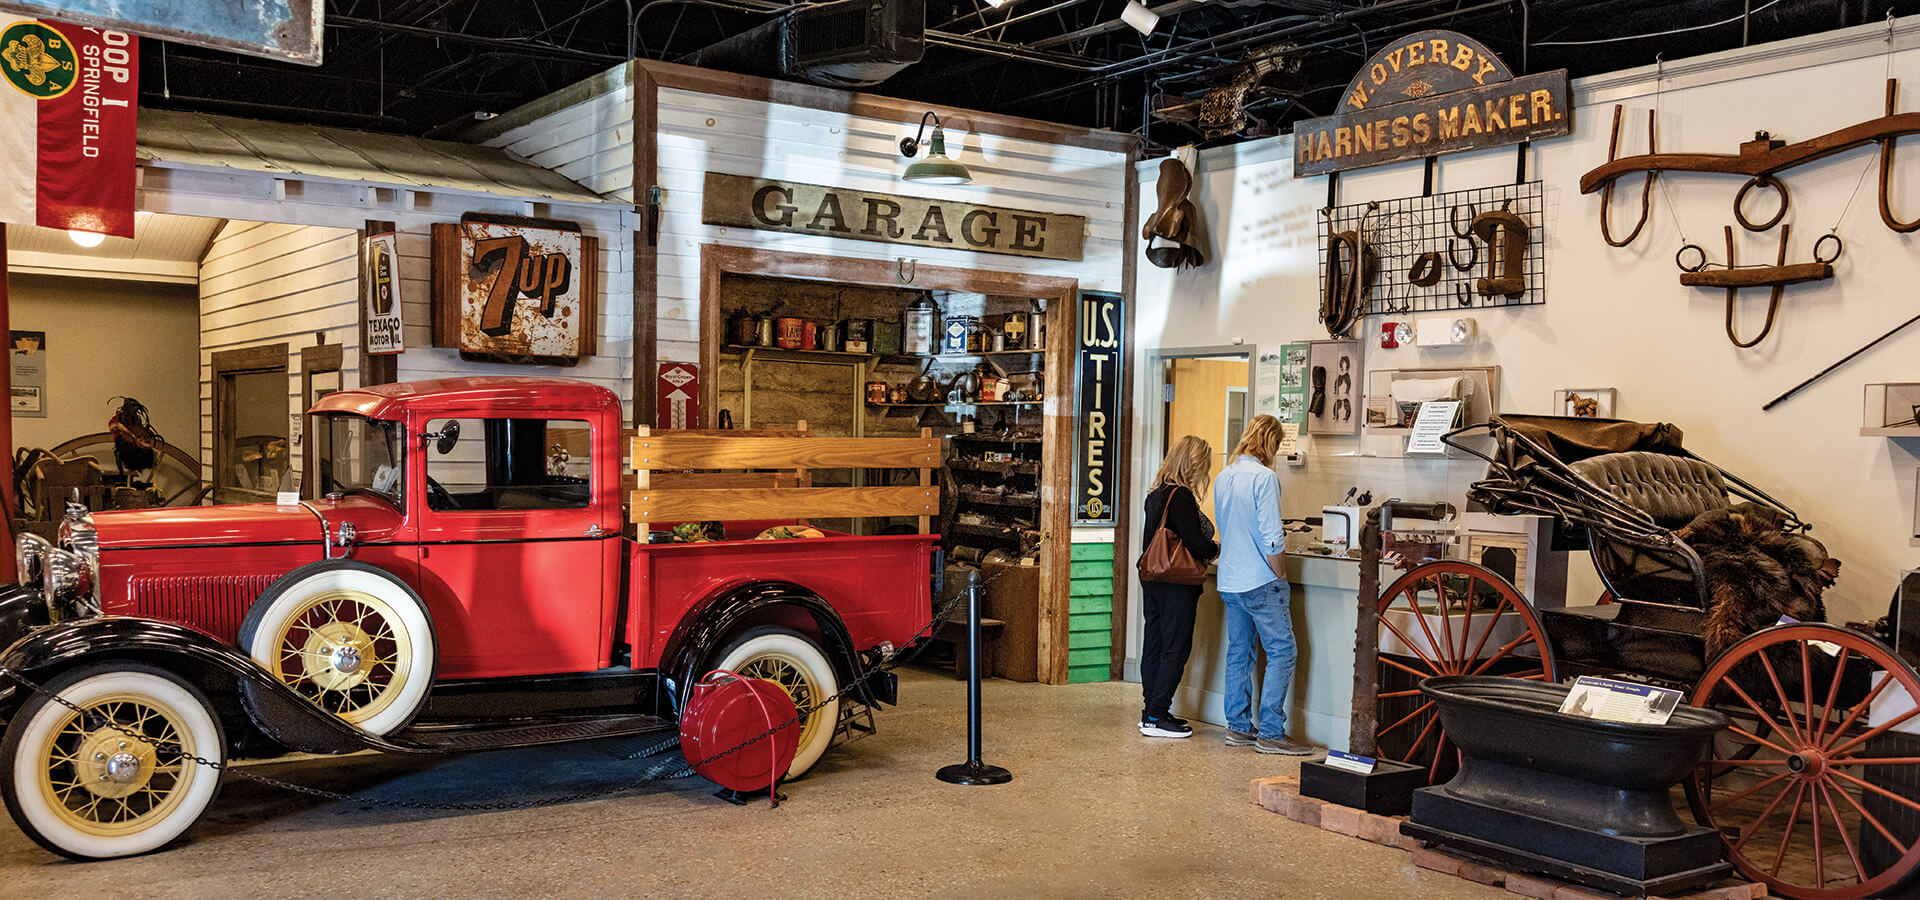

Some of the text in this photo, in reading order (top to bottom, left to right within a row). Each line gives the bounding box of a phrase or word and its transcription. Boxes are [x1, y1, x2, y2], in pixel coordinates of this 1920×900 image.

[82, 45, 99, 158] SPRINGFIELD
[1298, 89, 1561, 163] HARNESS MAKER.
[751, 185, 1048, 252] GARAGE
[369, 317, 400, 333] TEXACO
[369, 333, 389, 346] MOTOR
[1083, 300, 1118, 349] U.S.
[1087, 353, 1109, 497] TIRES
